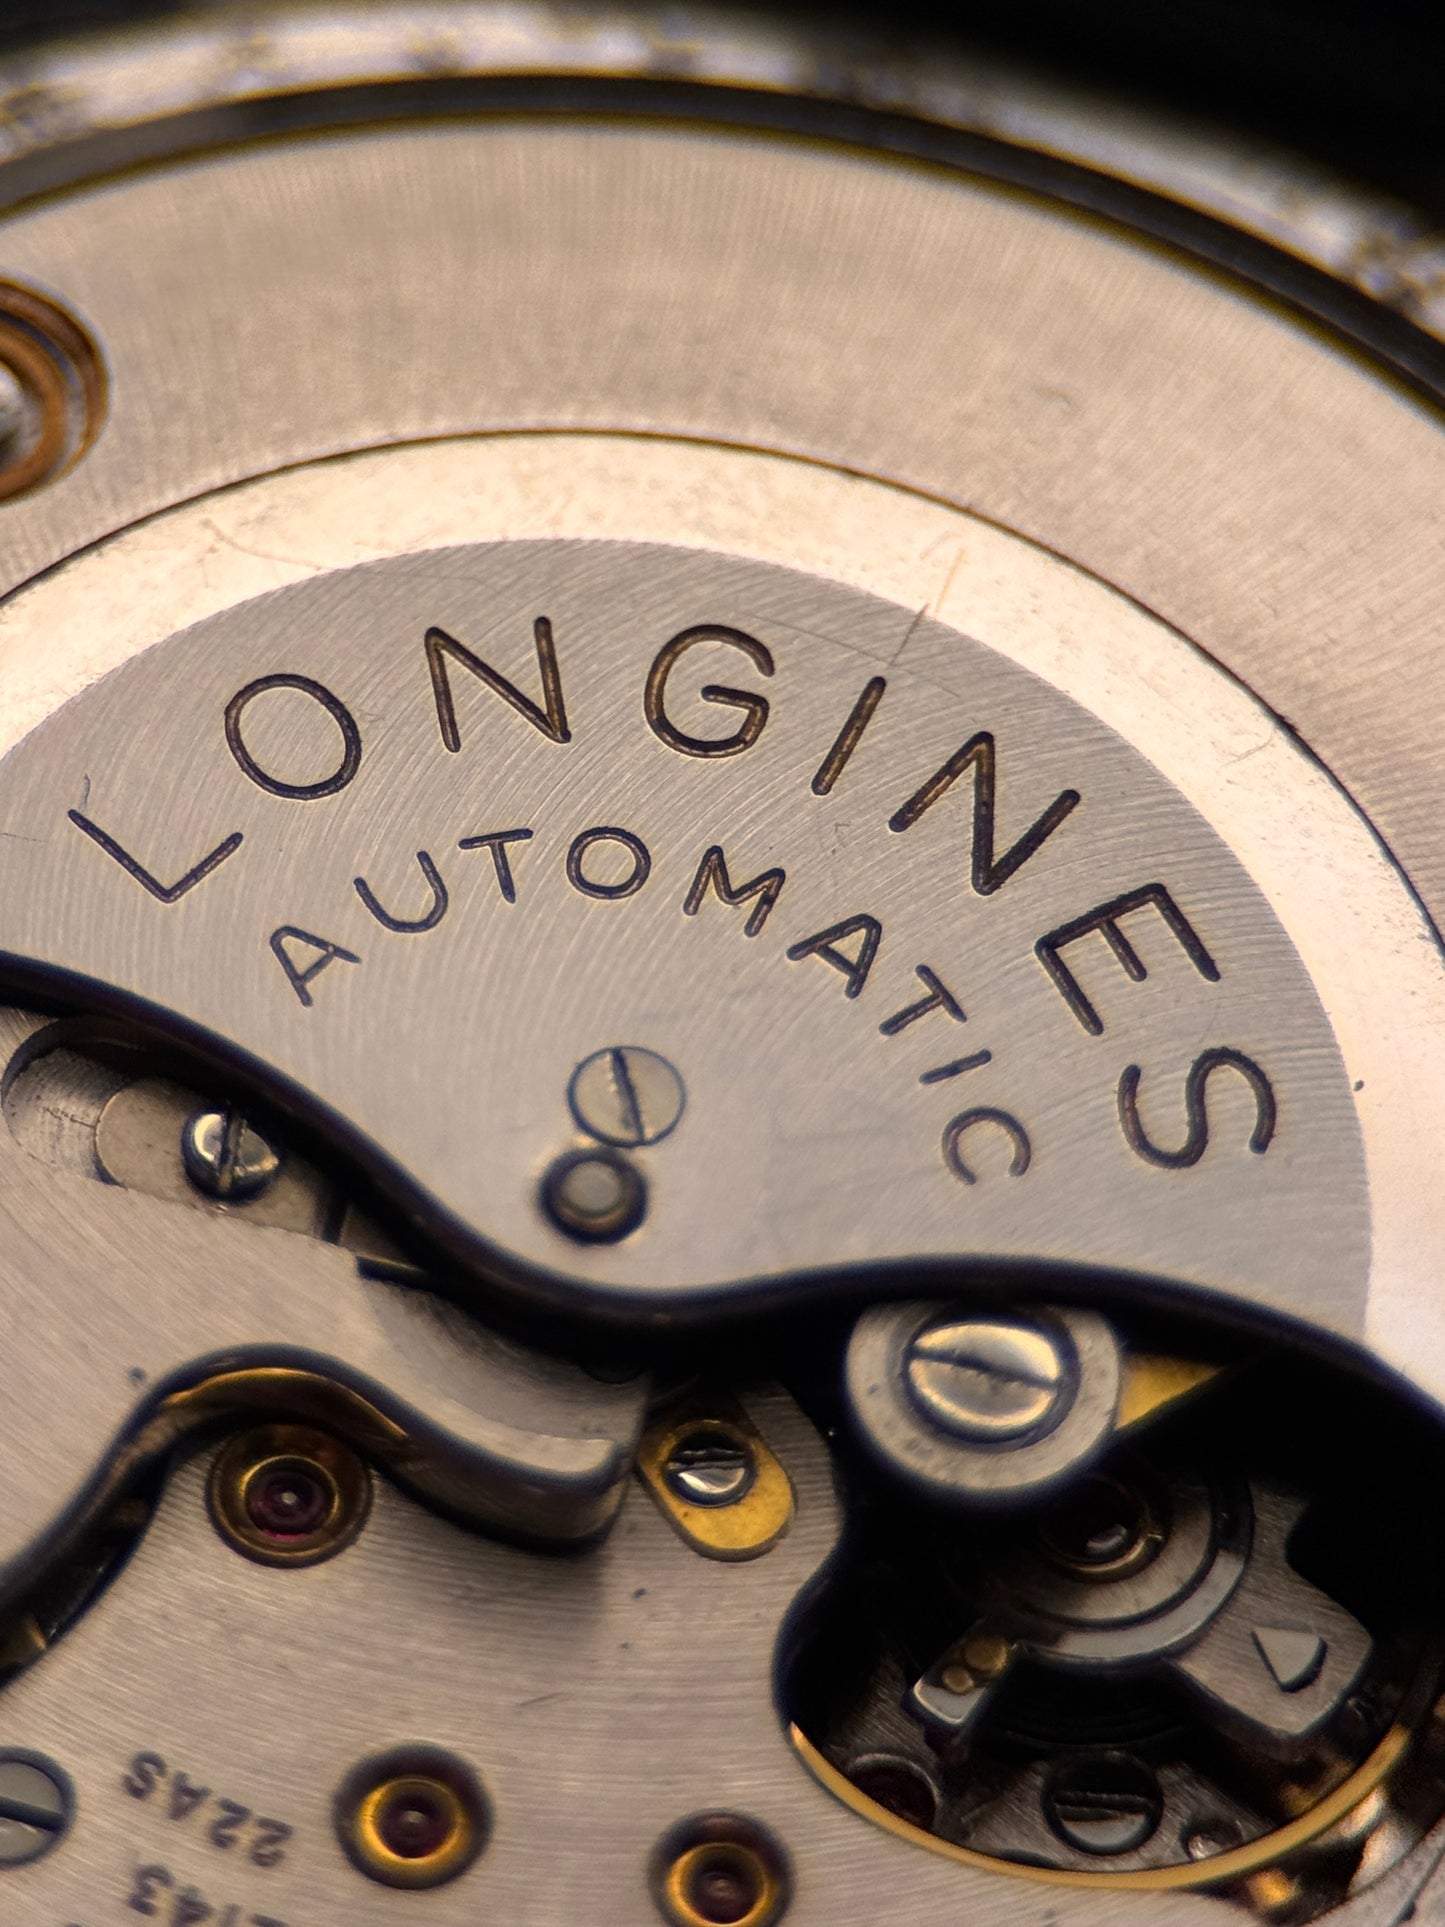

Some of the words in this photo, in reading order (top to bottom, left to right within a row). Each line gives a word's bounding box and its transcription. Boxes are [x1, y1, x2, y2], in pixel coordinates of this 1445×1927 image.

[69, 616, 1277, 1169] LONGINES
[269, 826, 1031, 1186] AUTOMATIC
[122, 1752, 293, 1867] 22AS
